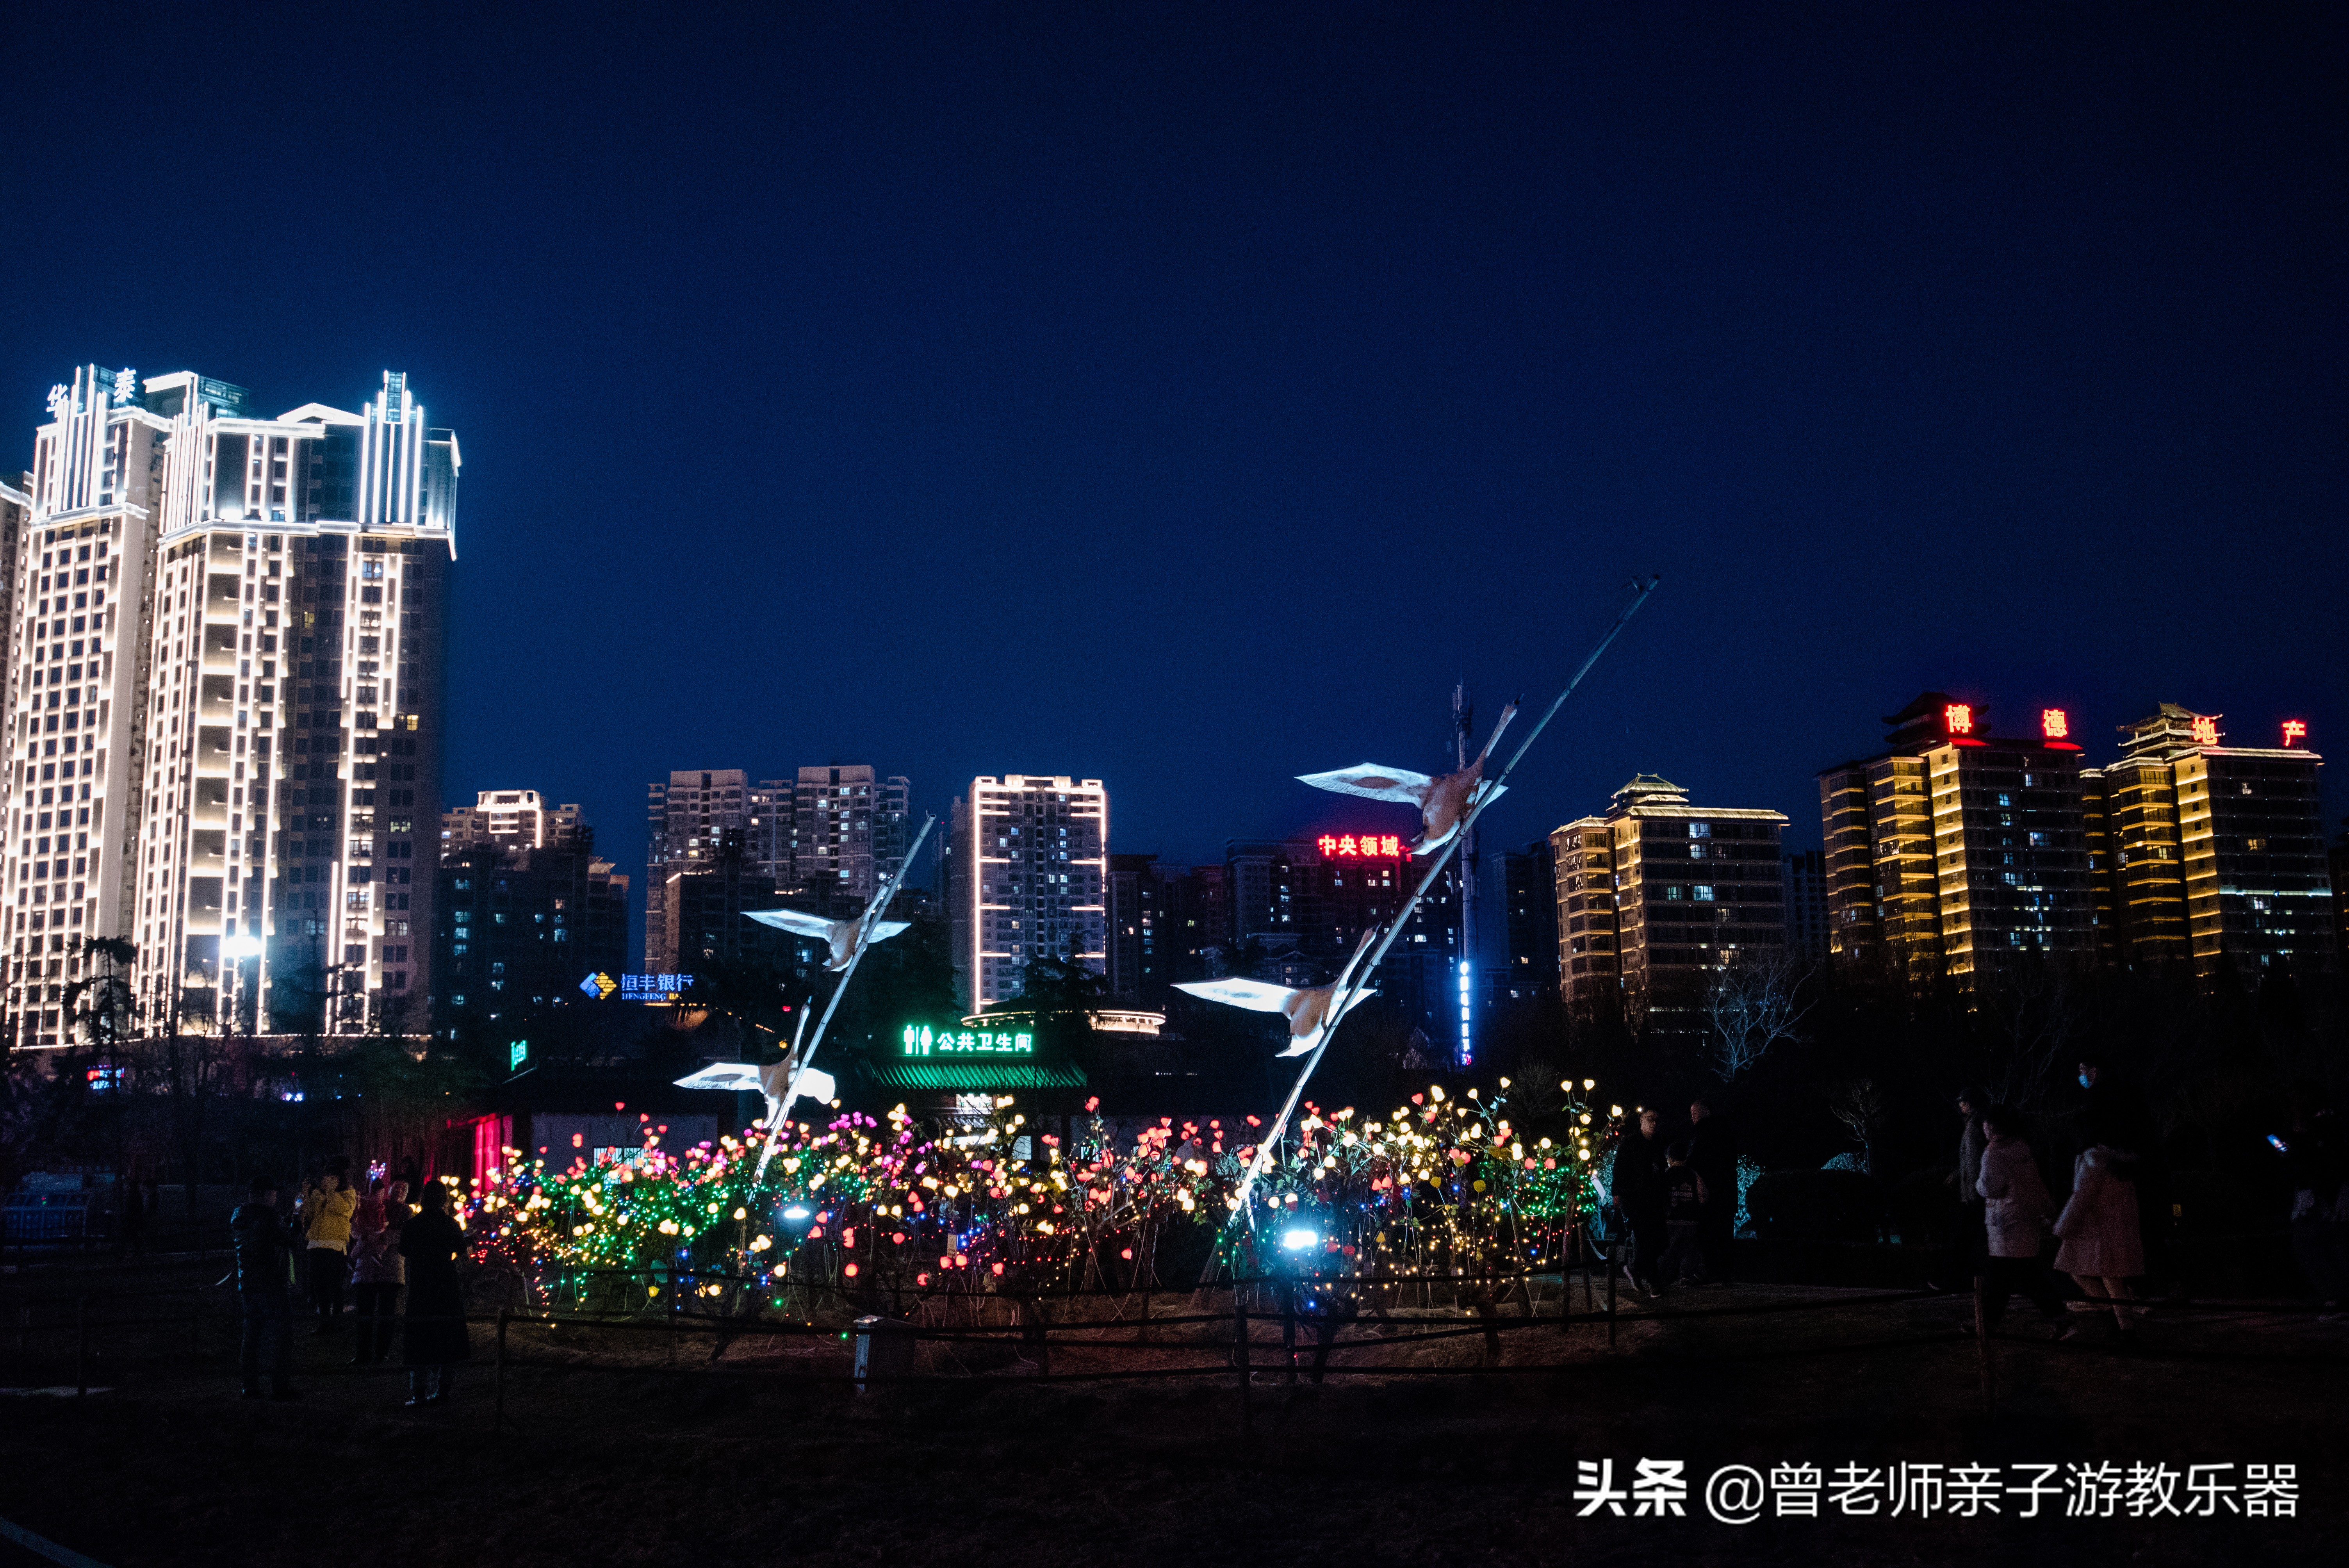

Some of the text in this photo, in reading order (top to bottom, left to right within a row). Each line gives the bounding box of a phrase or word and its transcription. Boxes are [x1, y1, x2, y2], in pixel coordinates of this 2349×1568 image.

[1319, 835, 1399, 857] 中央领域
[621, 973, 693, 991] 恒丰银行
[937, 1033, 1032, 1052] 公共卫生间
